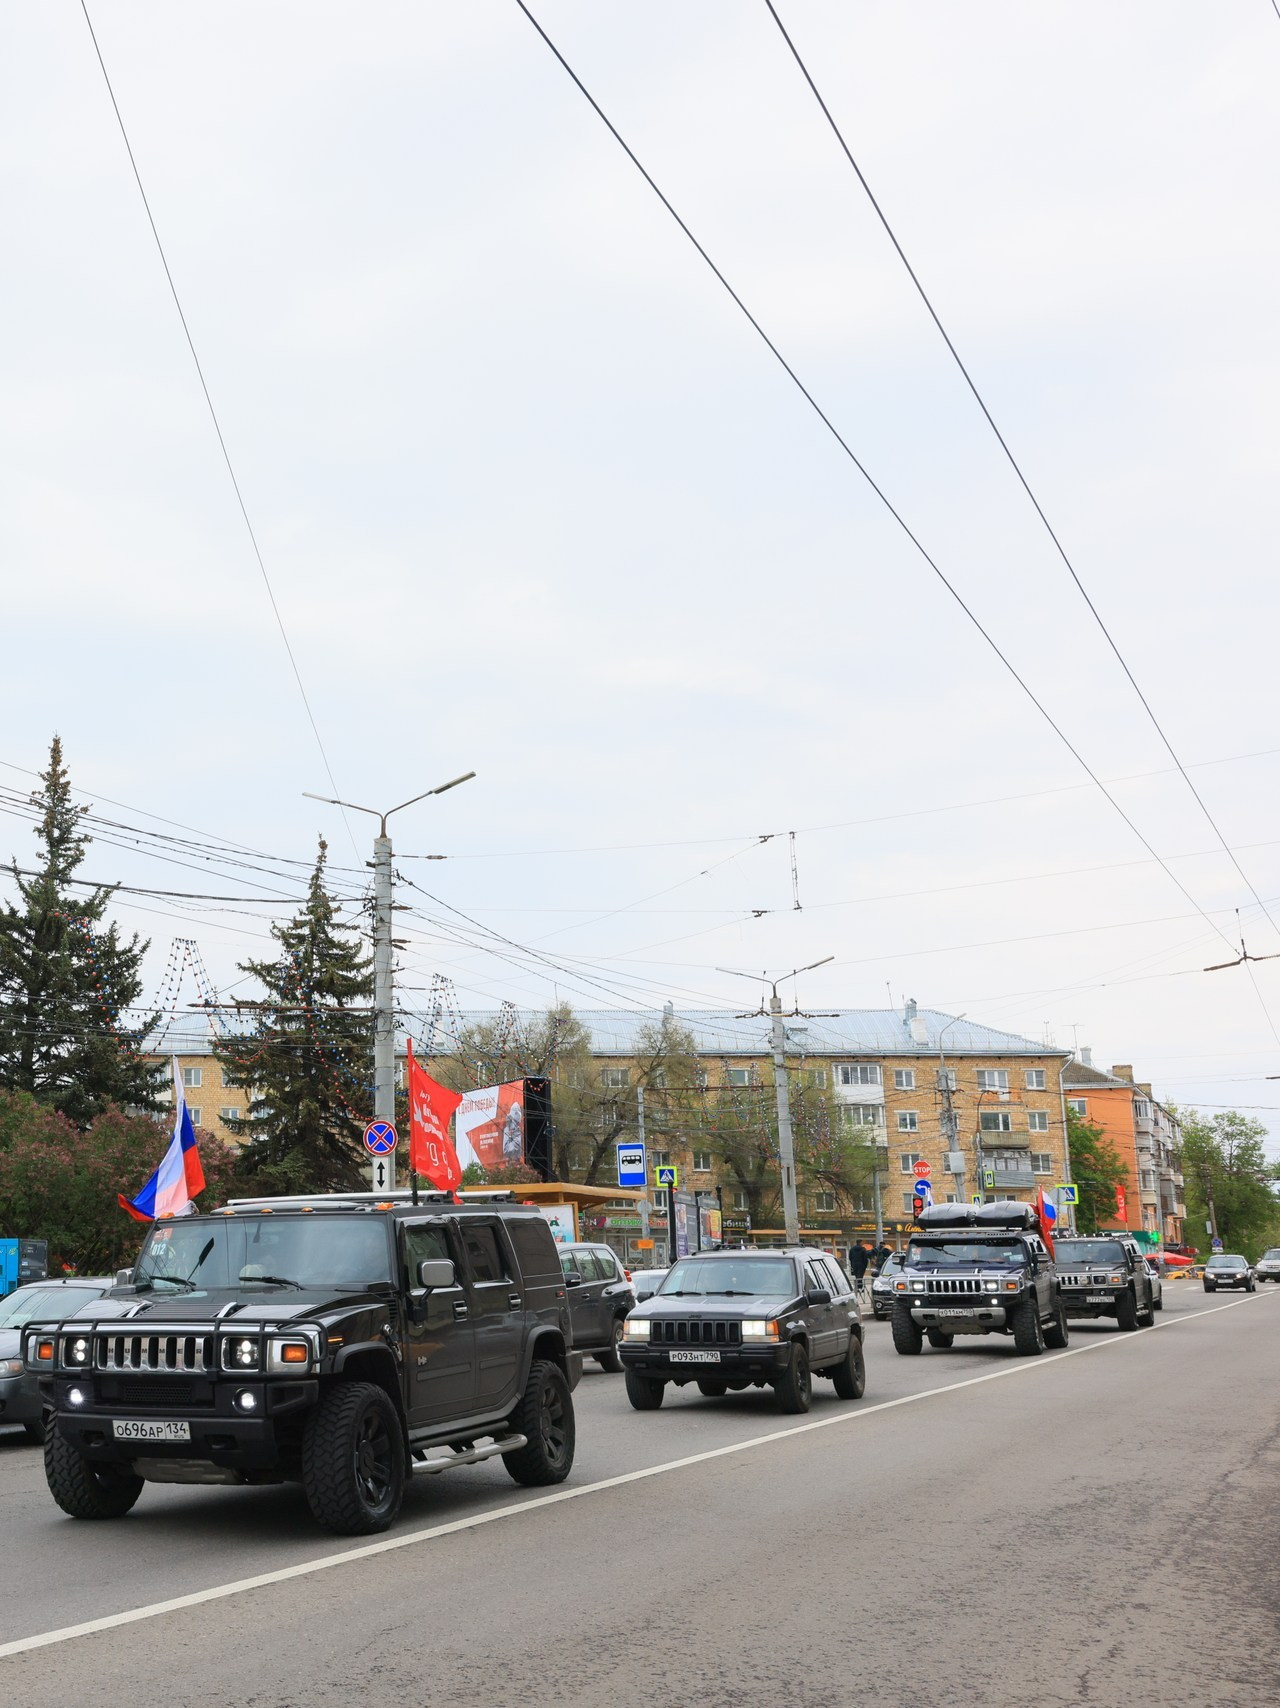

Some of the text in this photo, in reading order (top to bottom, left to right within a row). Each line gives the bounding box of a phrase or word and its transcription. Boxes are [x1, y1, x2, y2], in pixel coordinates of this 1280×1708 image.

[672, 1352, 704, 1361] Р093НТ
[116, 1422, 187, 1438] О696АР 134
